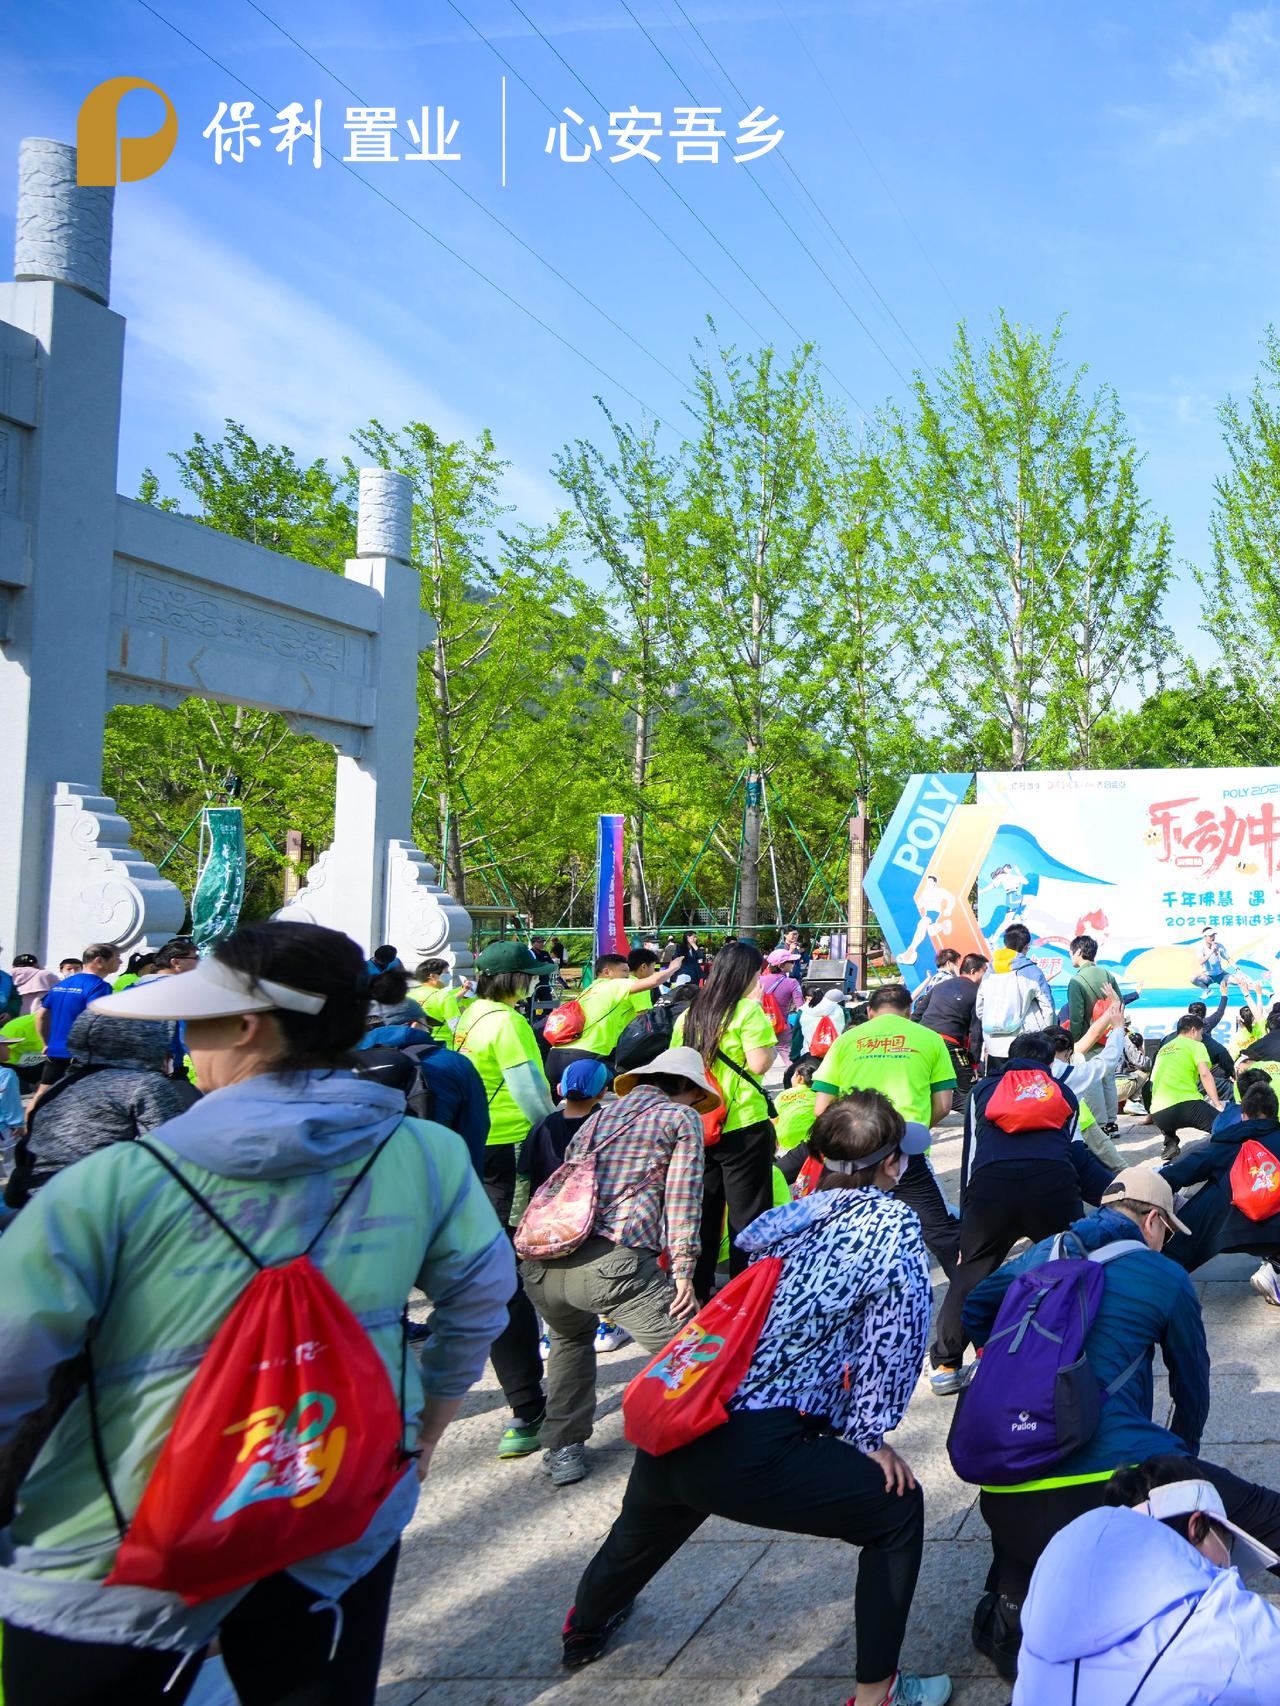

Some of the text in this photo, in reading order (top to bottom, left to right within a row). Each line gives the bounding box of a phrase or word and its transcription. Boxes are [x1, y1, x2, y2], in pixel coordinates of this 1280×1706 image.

[1223, 787, 1250, 800] POLY
[892, 776, 959, 876] POLY
[1162, 890, 1234, 907] 千年佛慧
[1249, 889, 1265, 906] 遇
